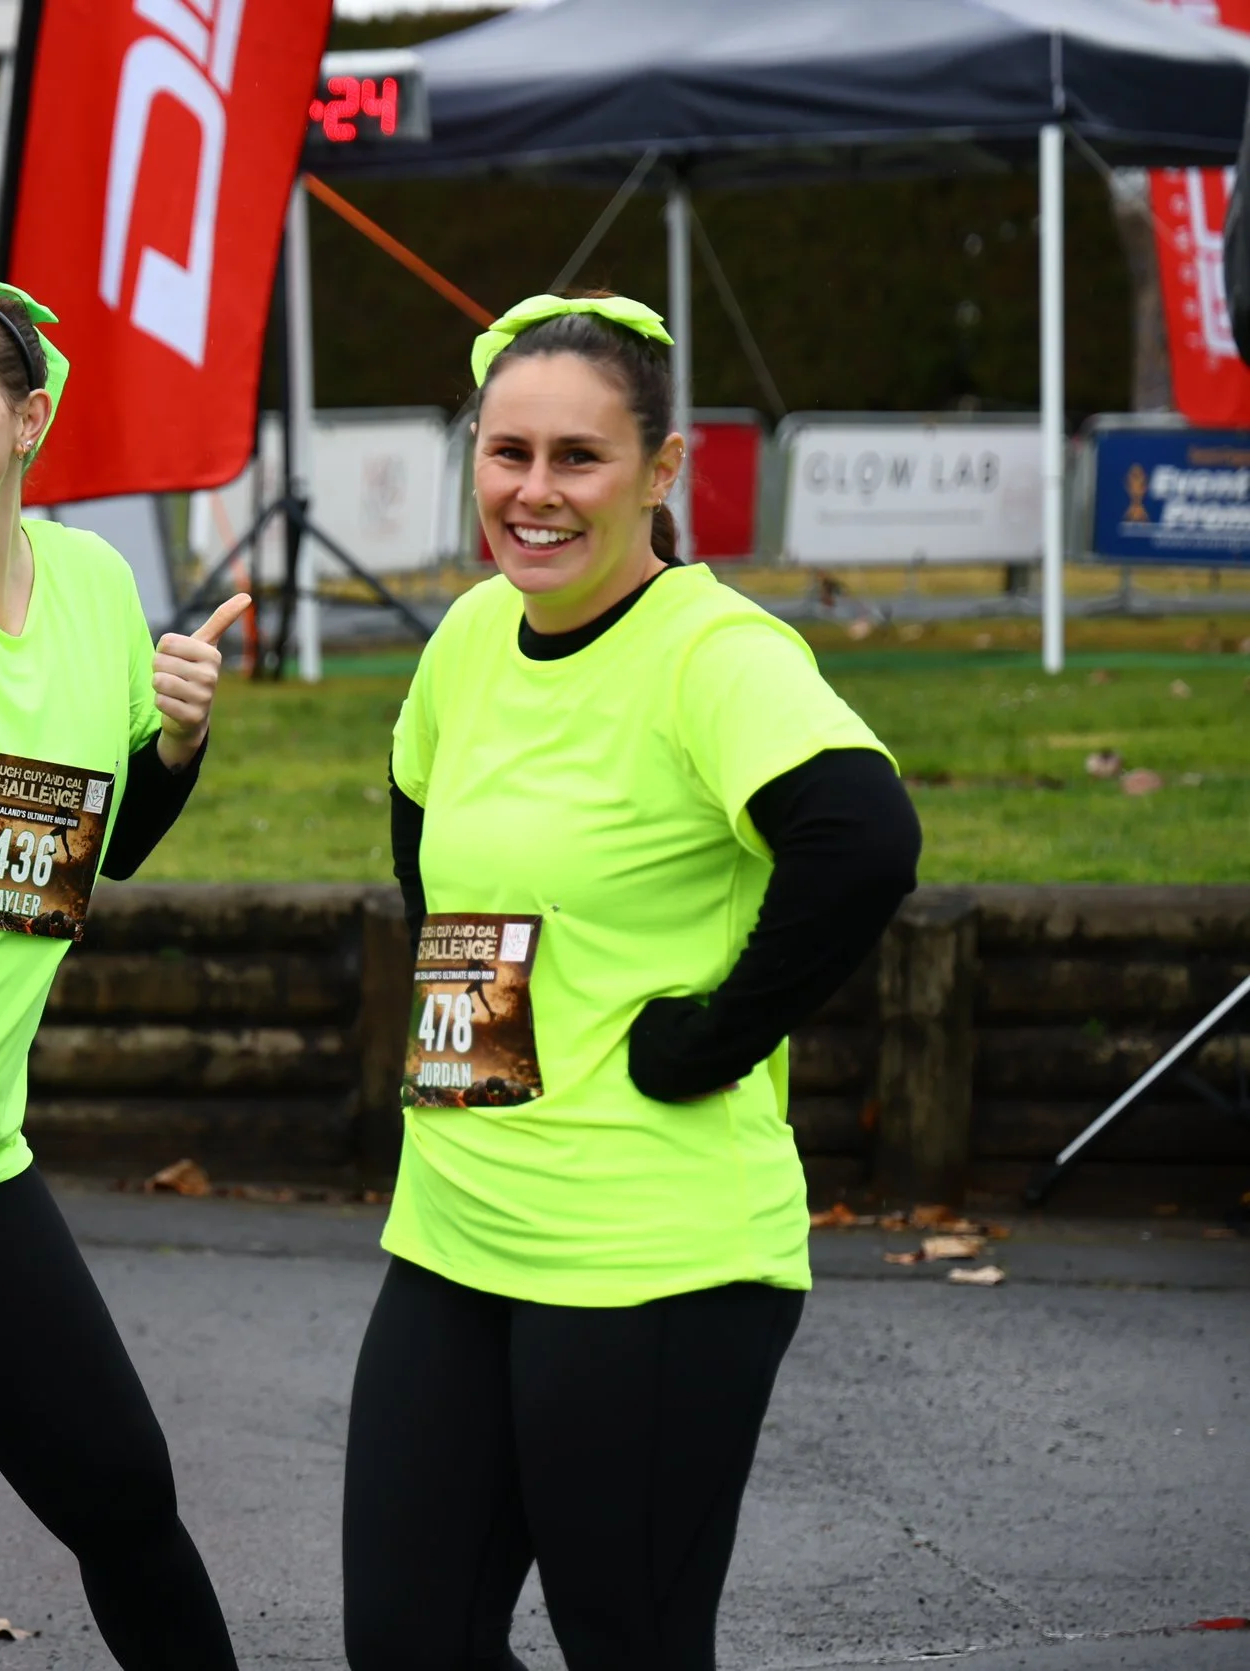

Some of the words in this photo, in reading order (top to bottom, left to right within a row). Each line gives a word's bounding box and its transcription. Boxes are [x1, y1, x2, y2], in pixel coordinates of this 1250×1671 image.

[66, 777, 83, 790] GAL
[27, 812, 54, 824] ULTIMATE
[54, 816, 66, 826] MUD
[66, 818, 78, 827] RUN
[476, 925, 498, 938] GAL
[418, 993, 472, 1053] 478
[417, 1062, 472, 1087] JORDAN
